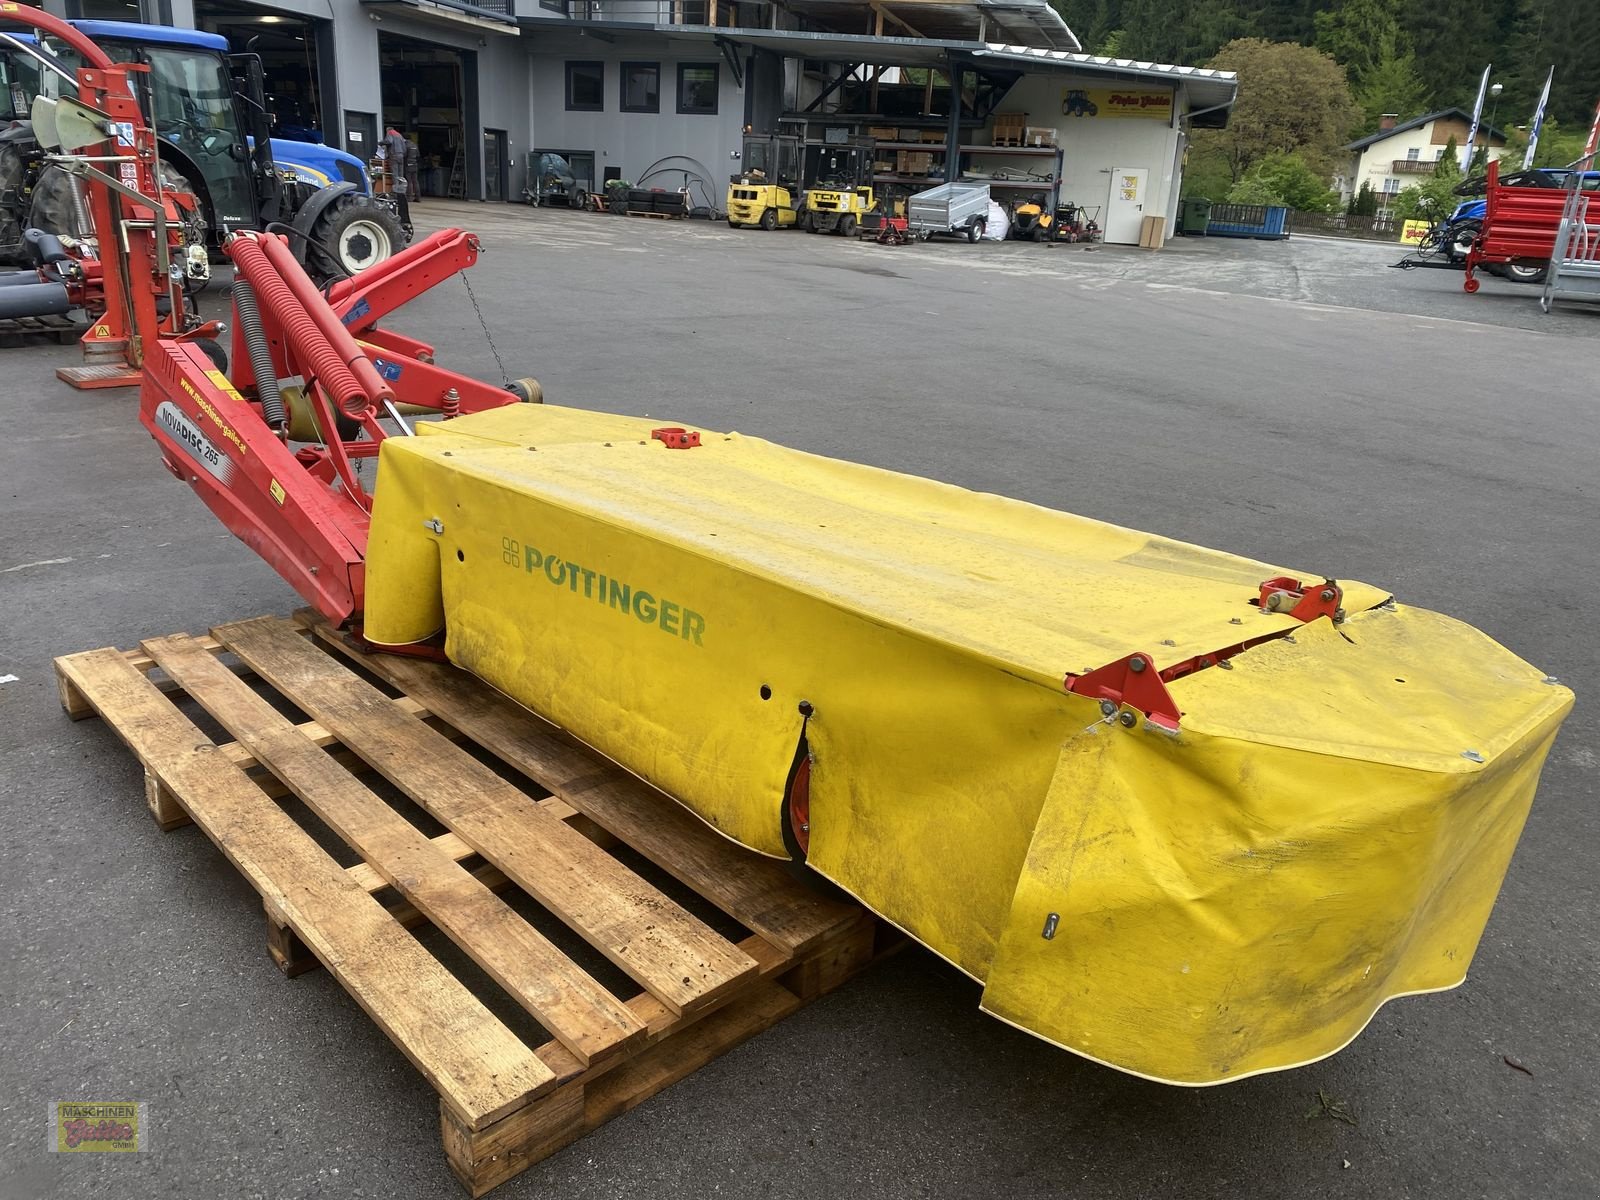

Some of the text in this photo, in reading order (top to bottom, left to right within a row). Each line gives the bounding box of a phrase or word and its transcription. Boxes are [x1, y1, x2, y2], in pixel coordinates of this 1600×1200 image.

[295, 174, 319, 186] olland
[813, 192, 841, 201] TCM
[180, 377, 247, 455] www.maschinen-gailer.at
[162, 408, 219, 466] NOVADISC 265
